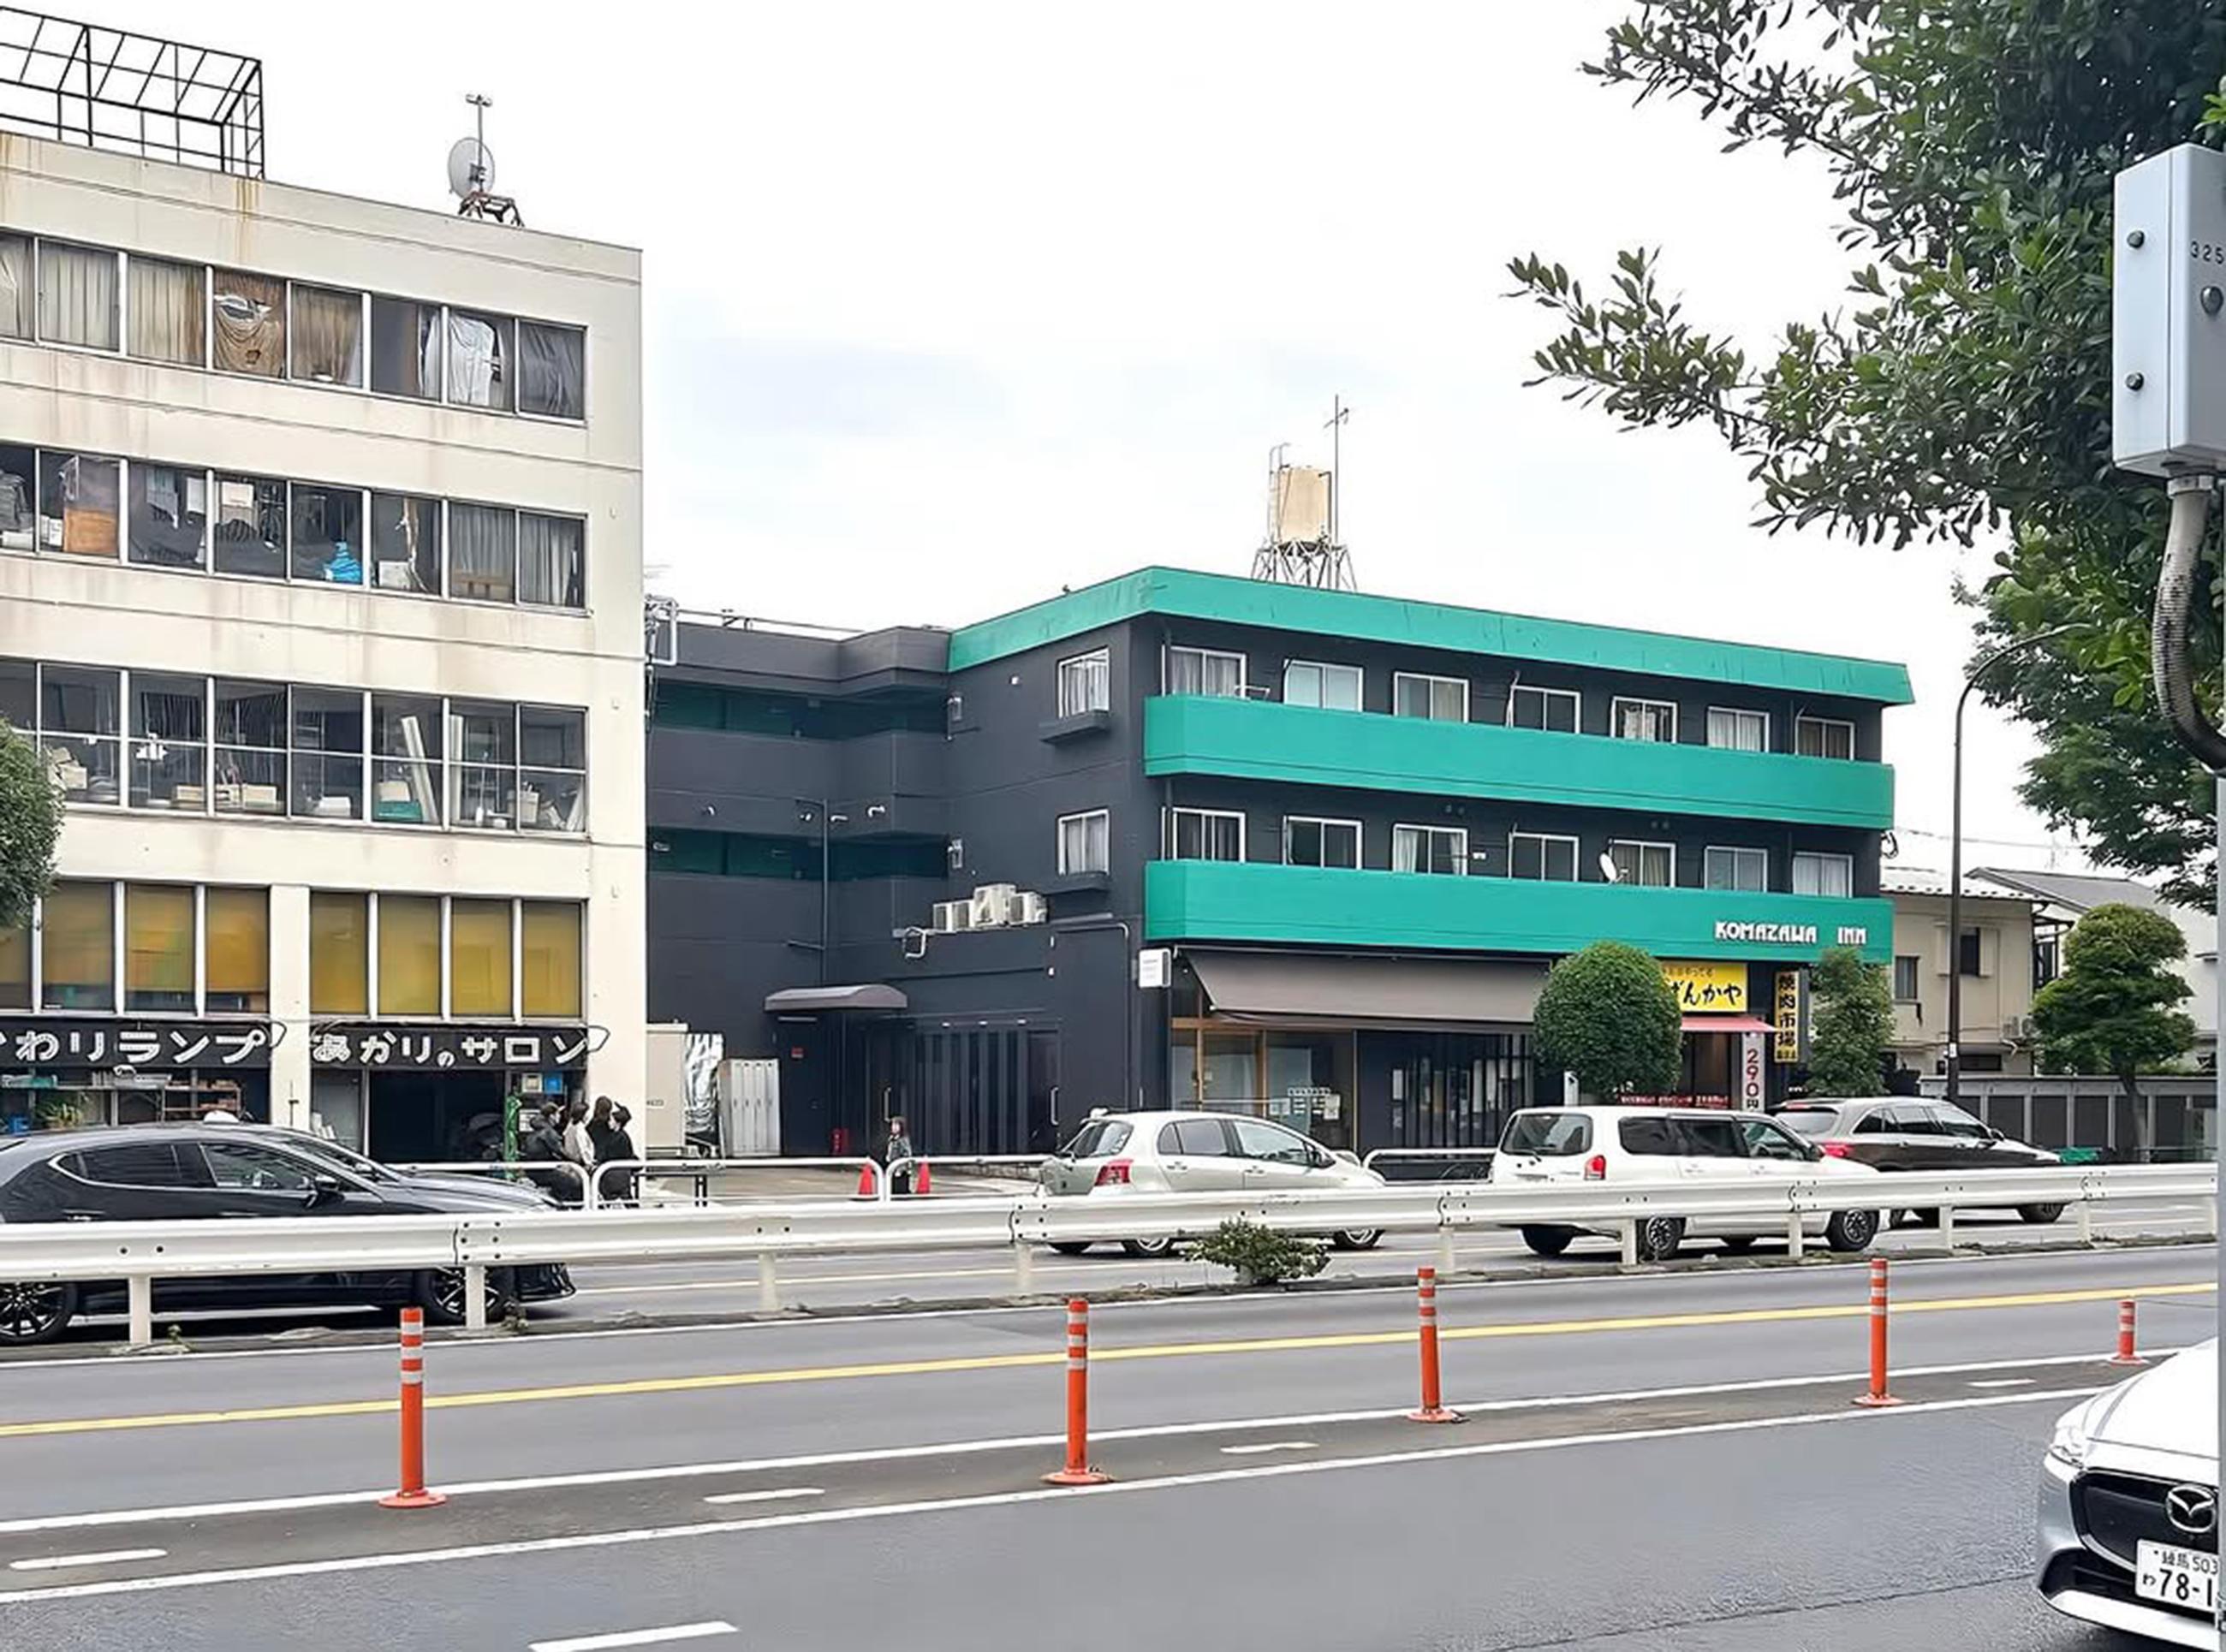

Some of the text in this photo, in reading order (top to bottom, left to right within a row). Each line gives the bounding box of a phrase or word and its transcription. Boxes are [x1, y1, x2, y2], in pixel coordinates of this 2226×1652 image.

[1715, 921, 1866, 945] KOMAZAWA INN
[1778, 974, 1795, 1046] 焼肉市場
[0, 1029, 266, 1064] わりランプ
[311, 1031, 588, 1067] あかりのサロン
